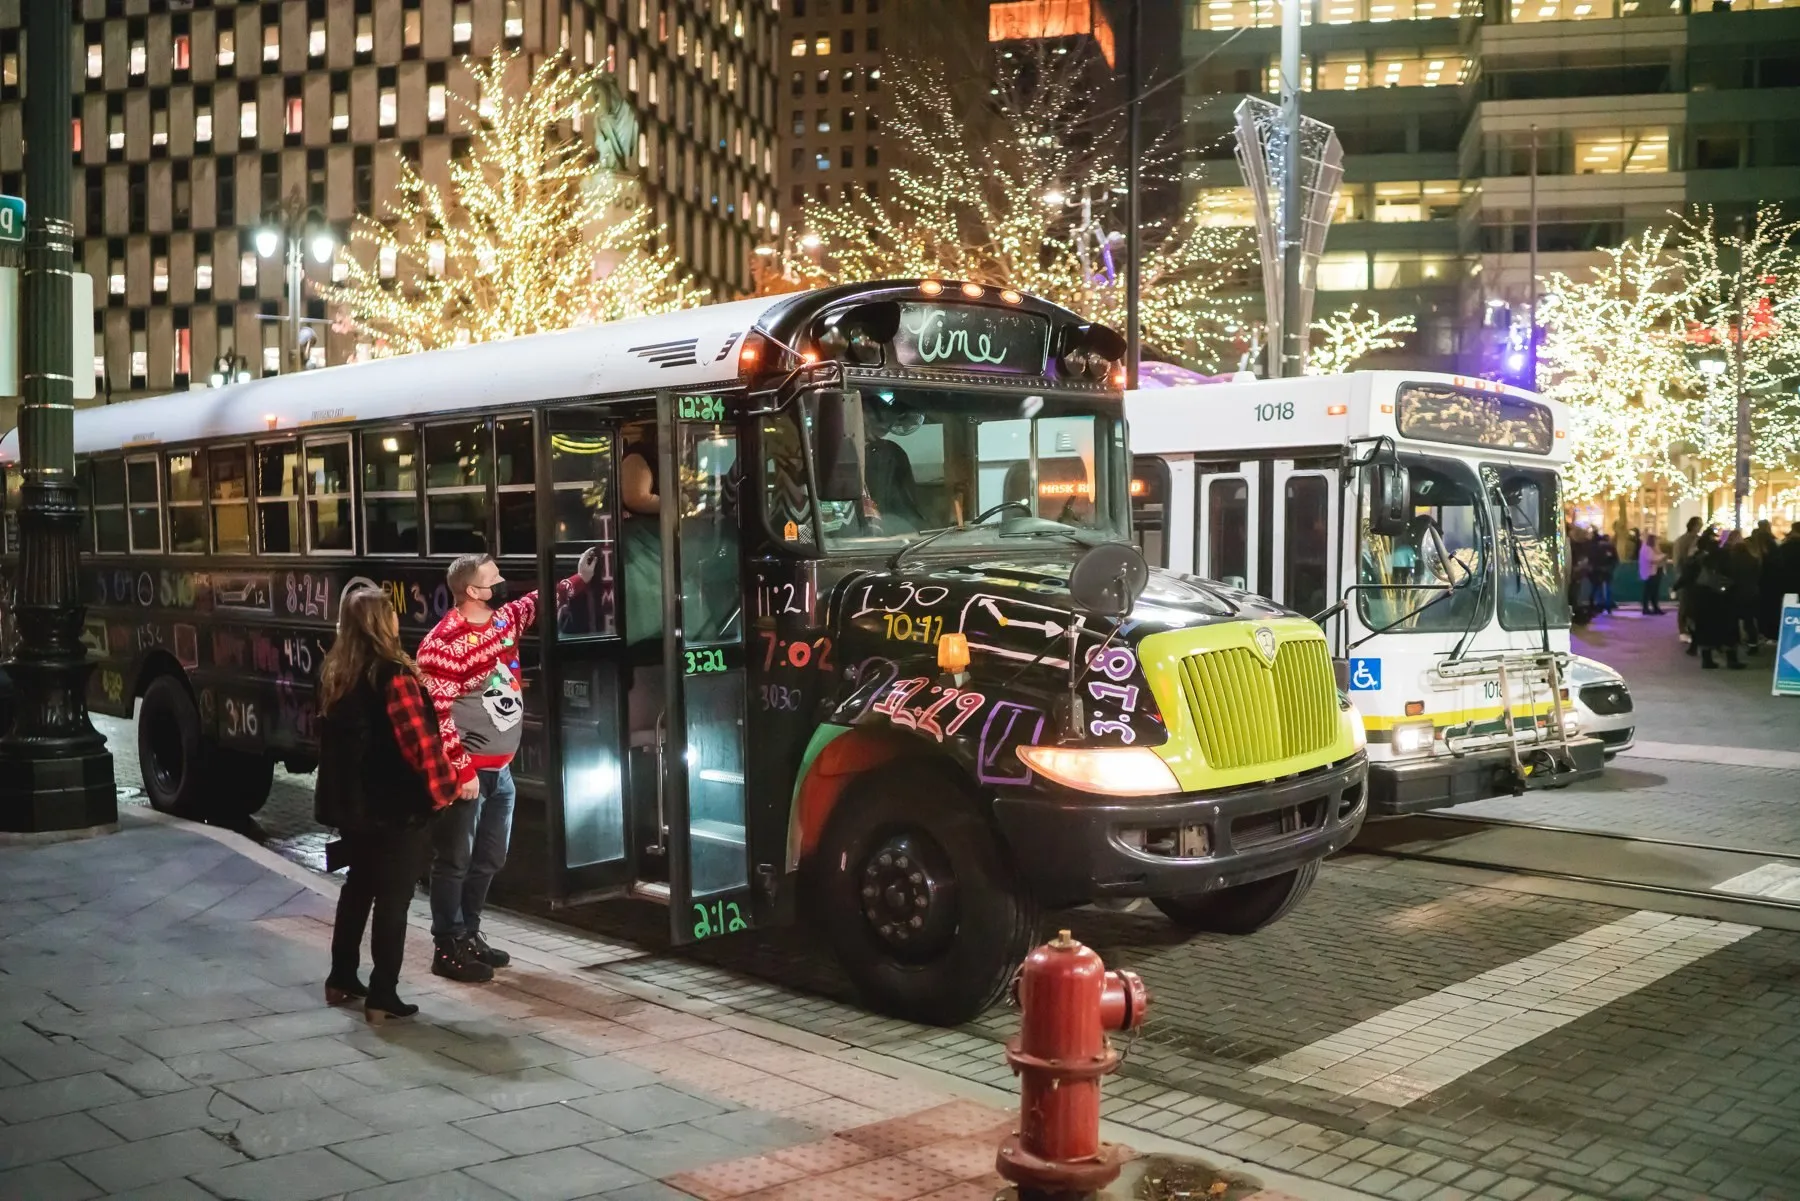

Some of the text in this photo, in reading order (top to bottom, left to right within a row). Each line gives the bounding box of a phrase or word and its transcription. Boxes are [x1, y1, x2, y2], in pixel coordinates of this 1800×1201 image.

[0, 207, 13, 234] q
[678, 396, 726, 421] 12:24
[1254, 401, 1295, 422] 1018
[1041, 483, 1074, 494] MASK
[286, 571, 329, 621] 8:24
[758, 581, 811, 617] 11:21
[851, 581, 950, 619] 1:30
[283, 638, 312, 673] 4:15
[684, 649, 728, 674] 3:21
[760, 634, 834, 673] 7:02
[872, 676, 986, 743] 12:29
[1084, 643, 1140, 745] 3:18
[225, 698, 258, 737] 3:16
[693, 900, 748, 940] 2:12
